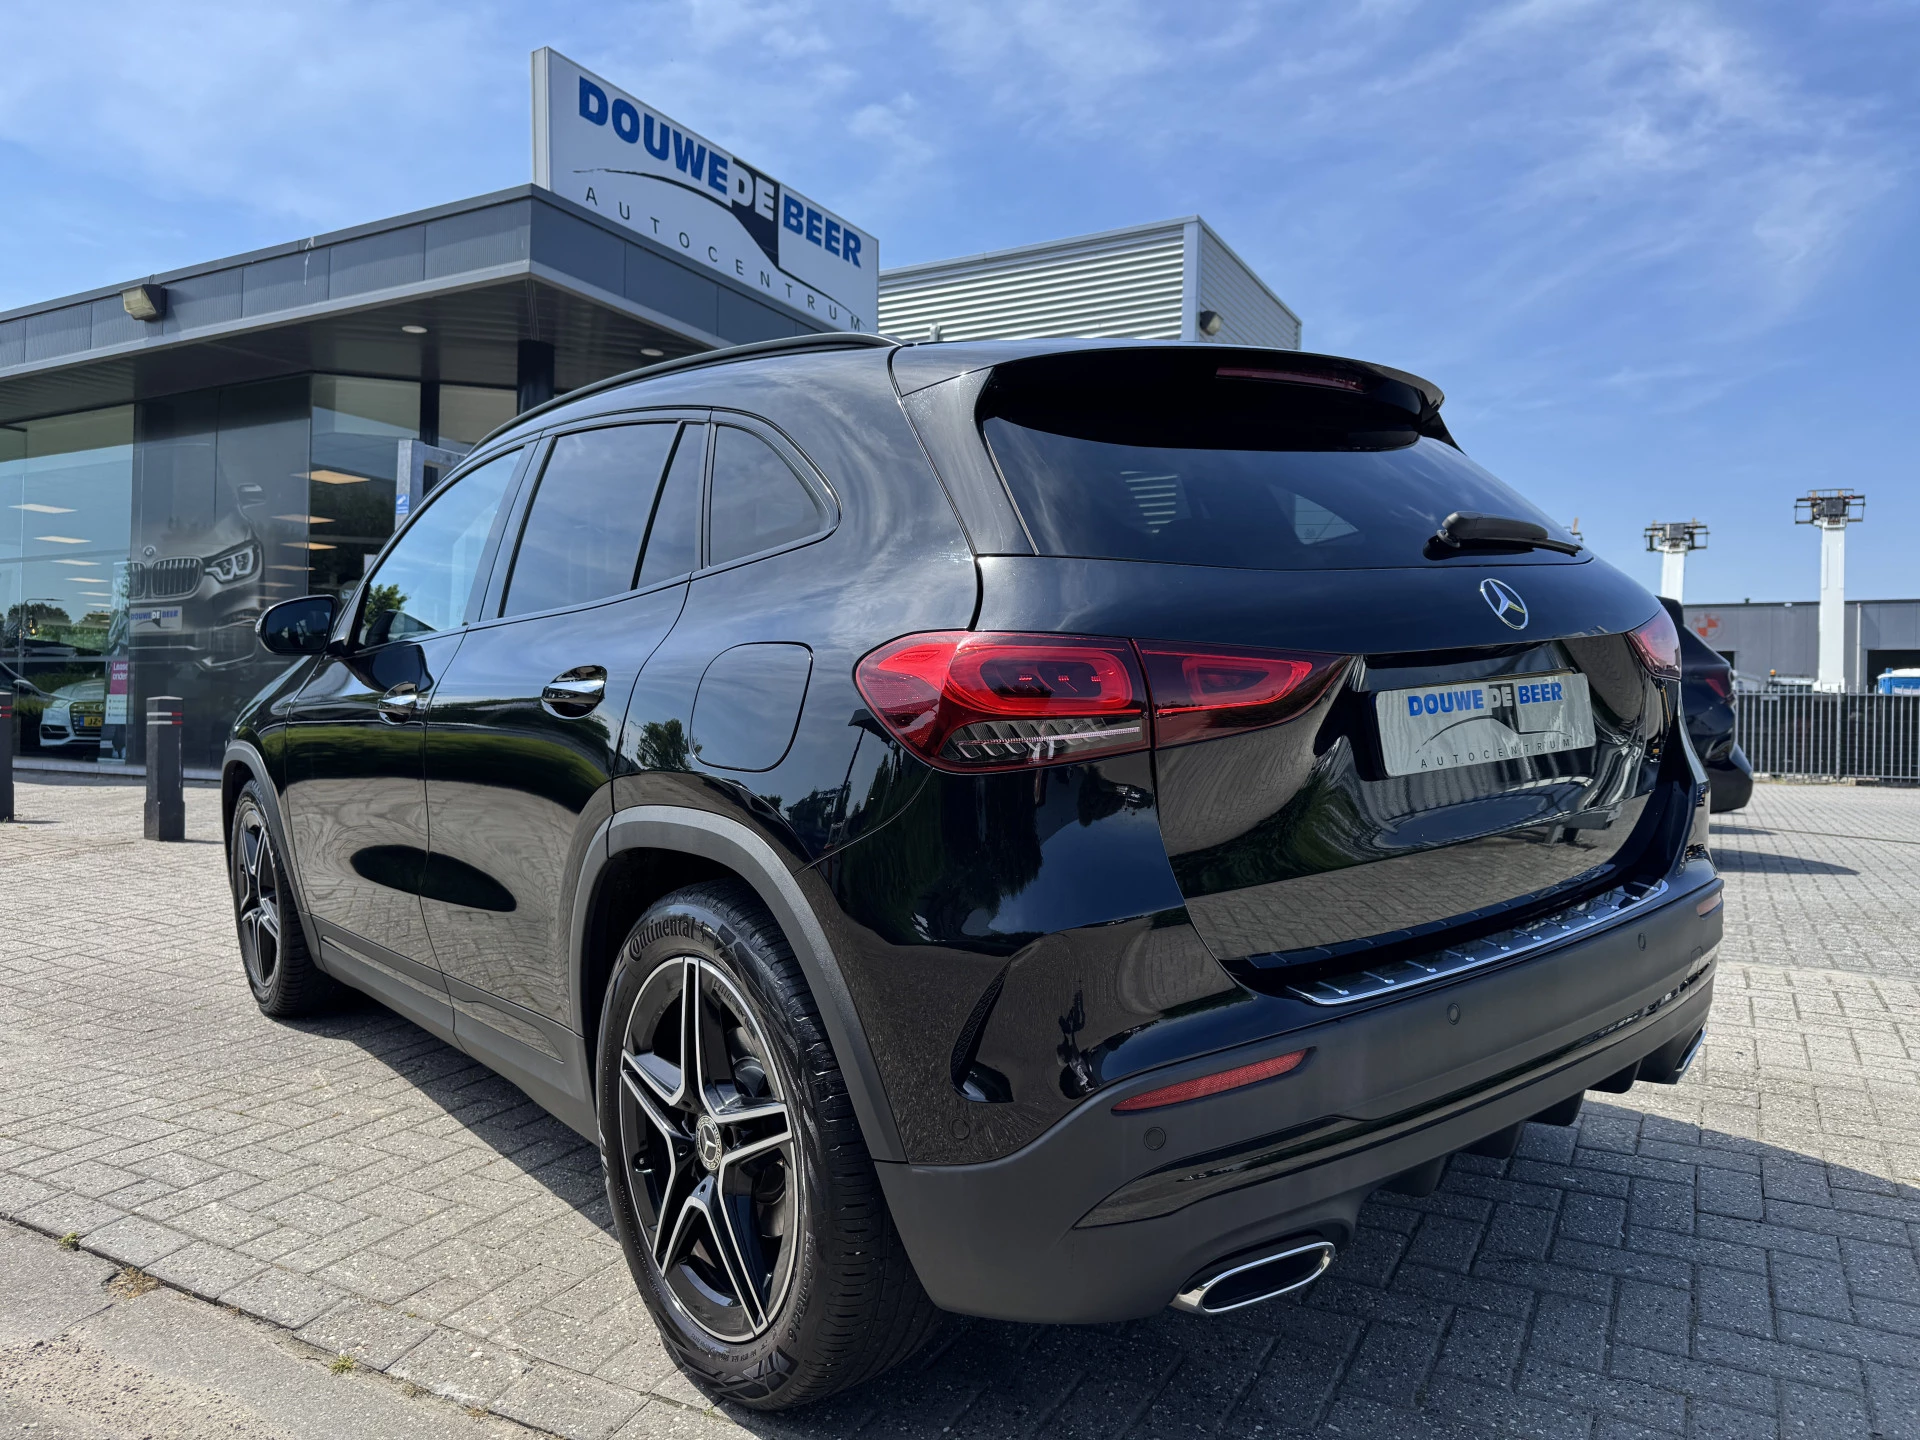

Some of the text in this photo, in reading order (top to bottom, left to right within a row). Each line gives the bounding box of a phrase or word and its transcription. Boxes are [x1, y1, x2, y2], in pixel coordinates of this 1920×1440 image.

[579, 75, 861, 269] DOUWE DE BEER
[585, 186, 861, 331] AUTOCENTRUM
[152, 611, 160, 619] DE
[1407, 682, 1563, 717] DOUWE DE BEER
[1420, 738, 1571, 769] AUTOCENTRUM
[629, 916, 697, 962] Continental
